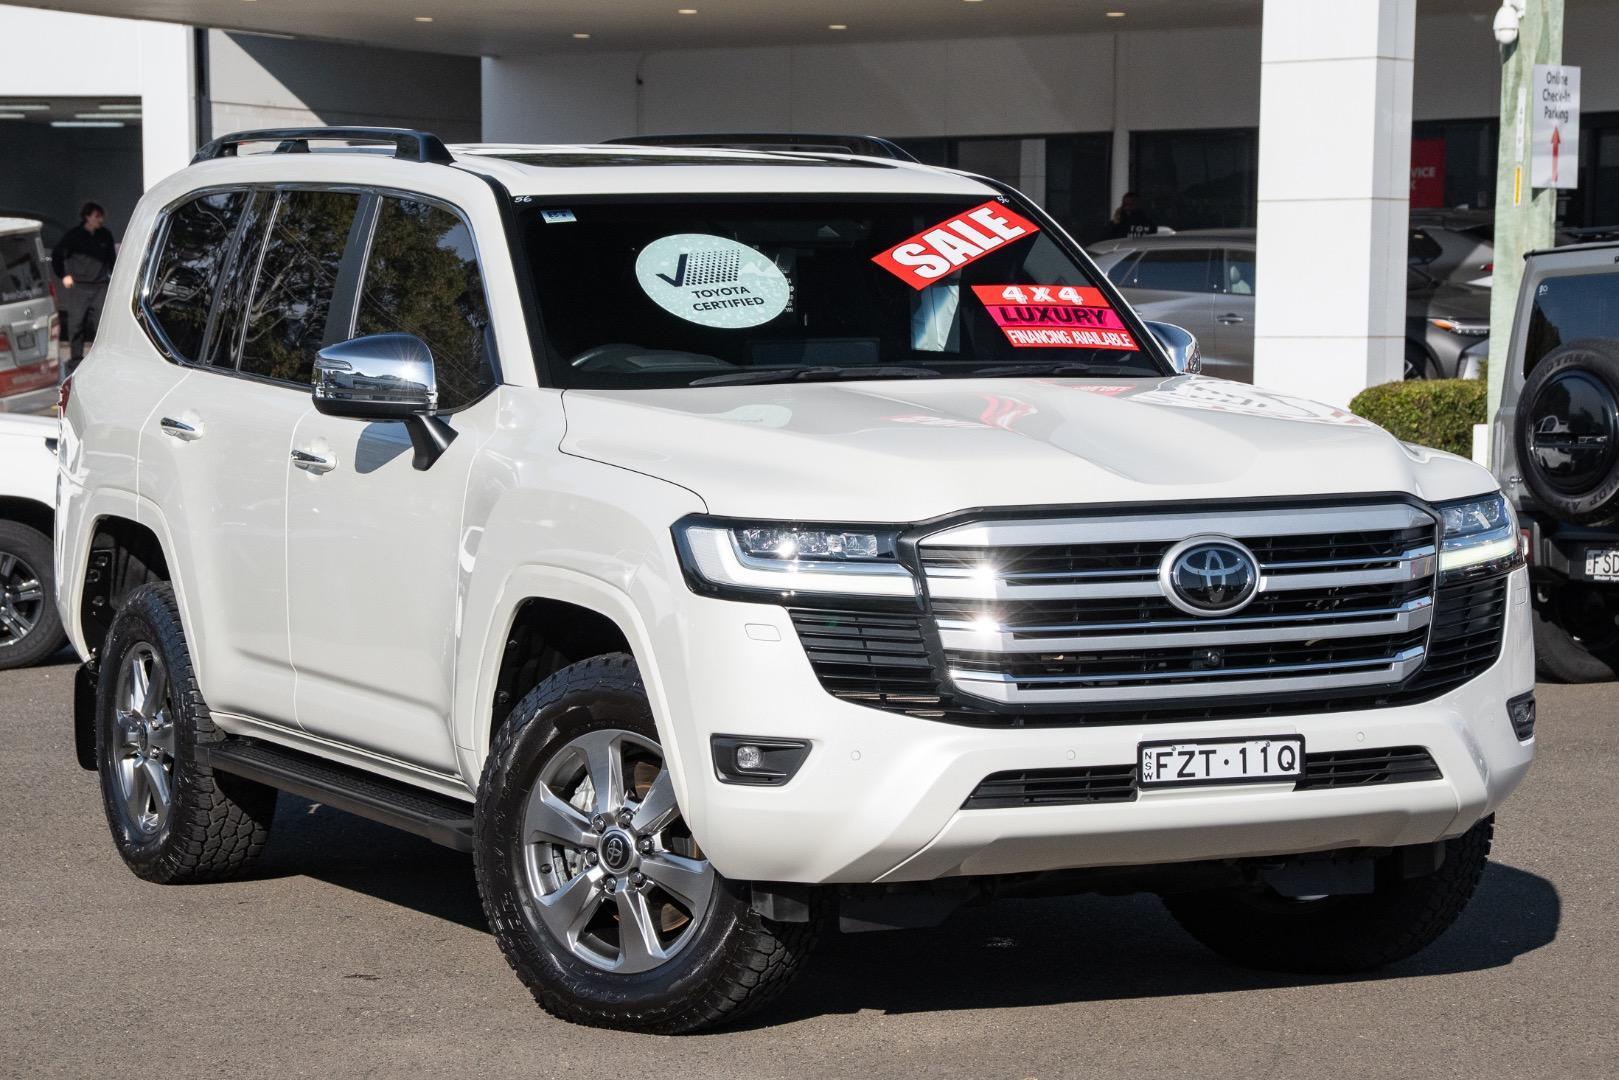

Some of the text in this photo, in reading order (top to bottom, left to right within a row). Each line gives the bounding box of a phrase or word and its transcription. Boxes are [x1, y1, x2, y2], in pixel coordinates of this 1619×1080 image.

[1546, 71, 1568, 85] Online
[1544, 108, 1569, 123] Parking
[892, 207, 1026, 279] SALE
[692, 286, 750, 299] TOYOTA
[692, 297, 764, 312] CERTIFIED
[1000, 306, 1106, 325] LUXURY
[1008, 330, 1131, 347] FINANCING AVAILABLE
